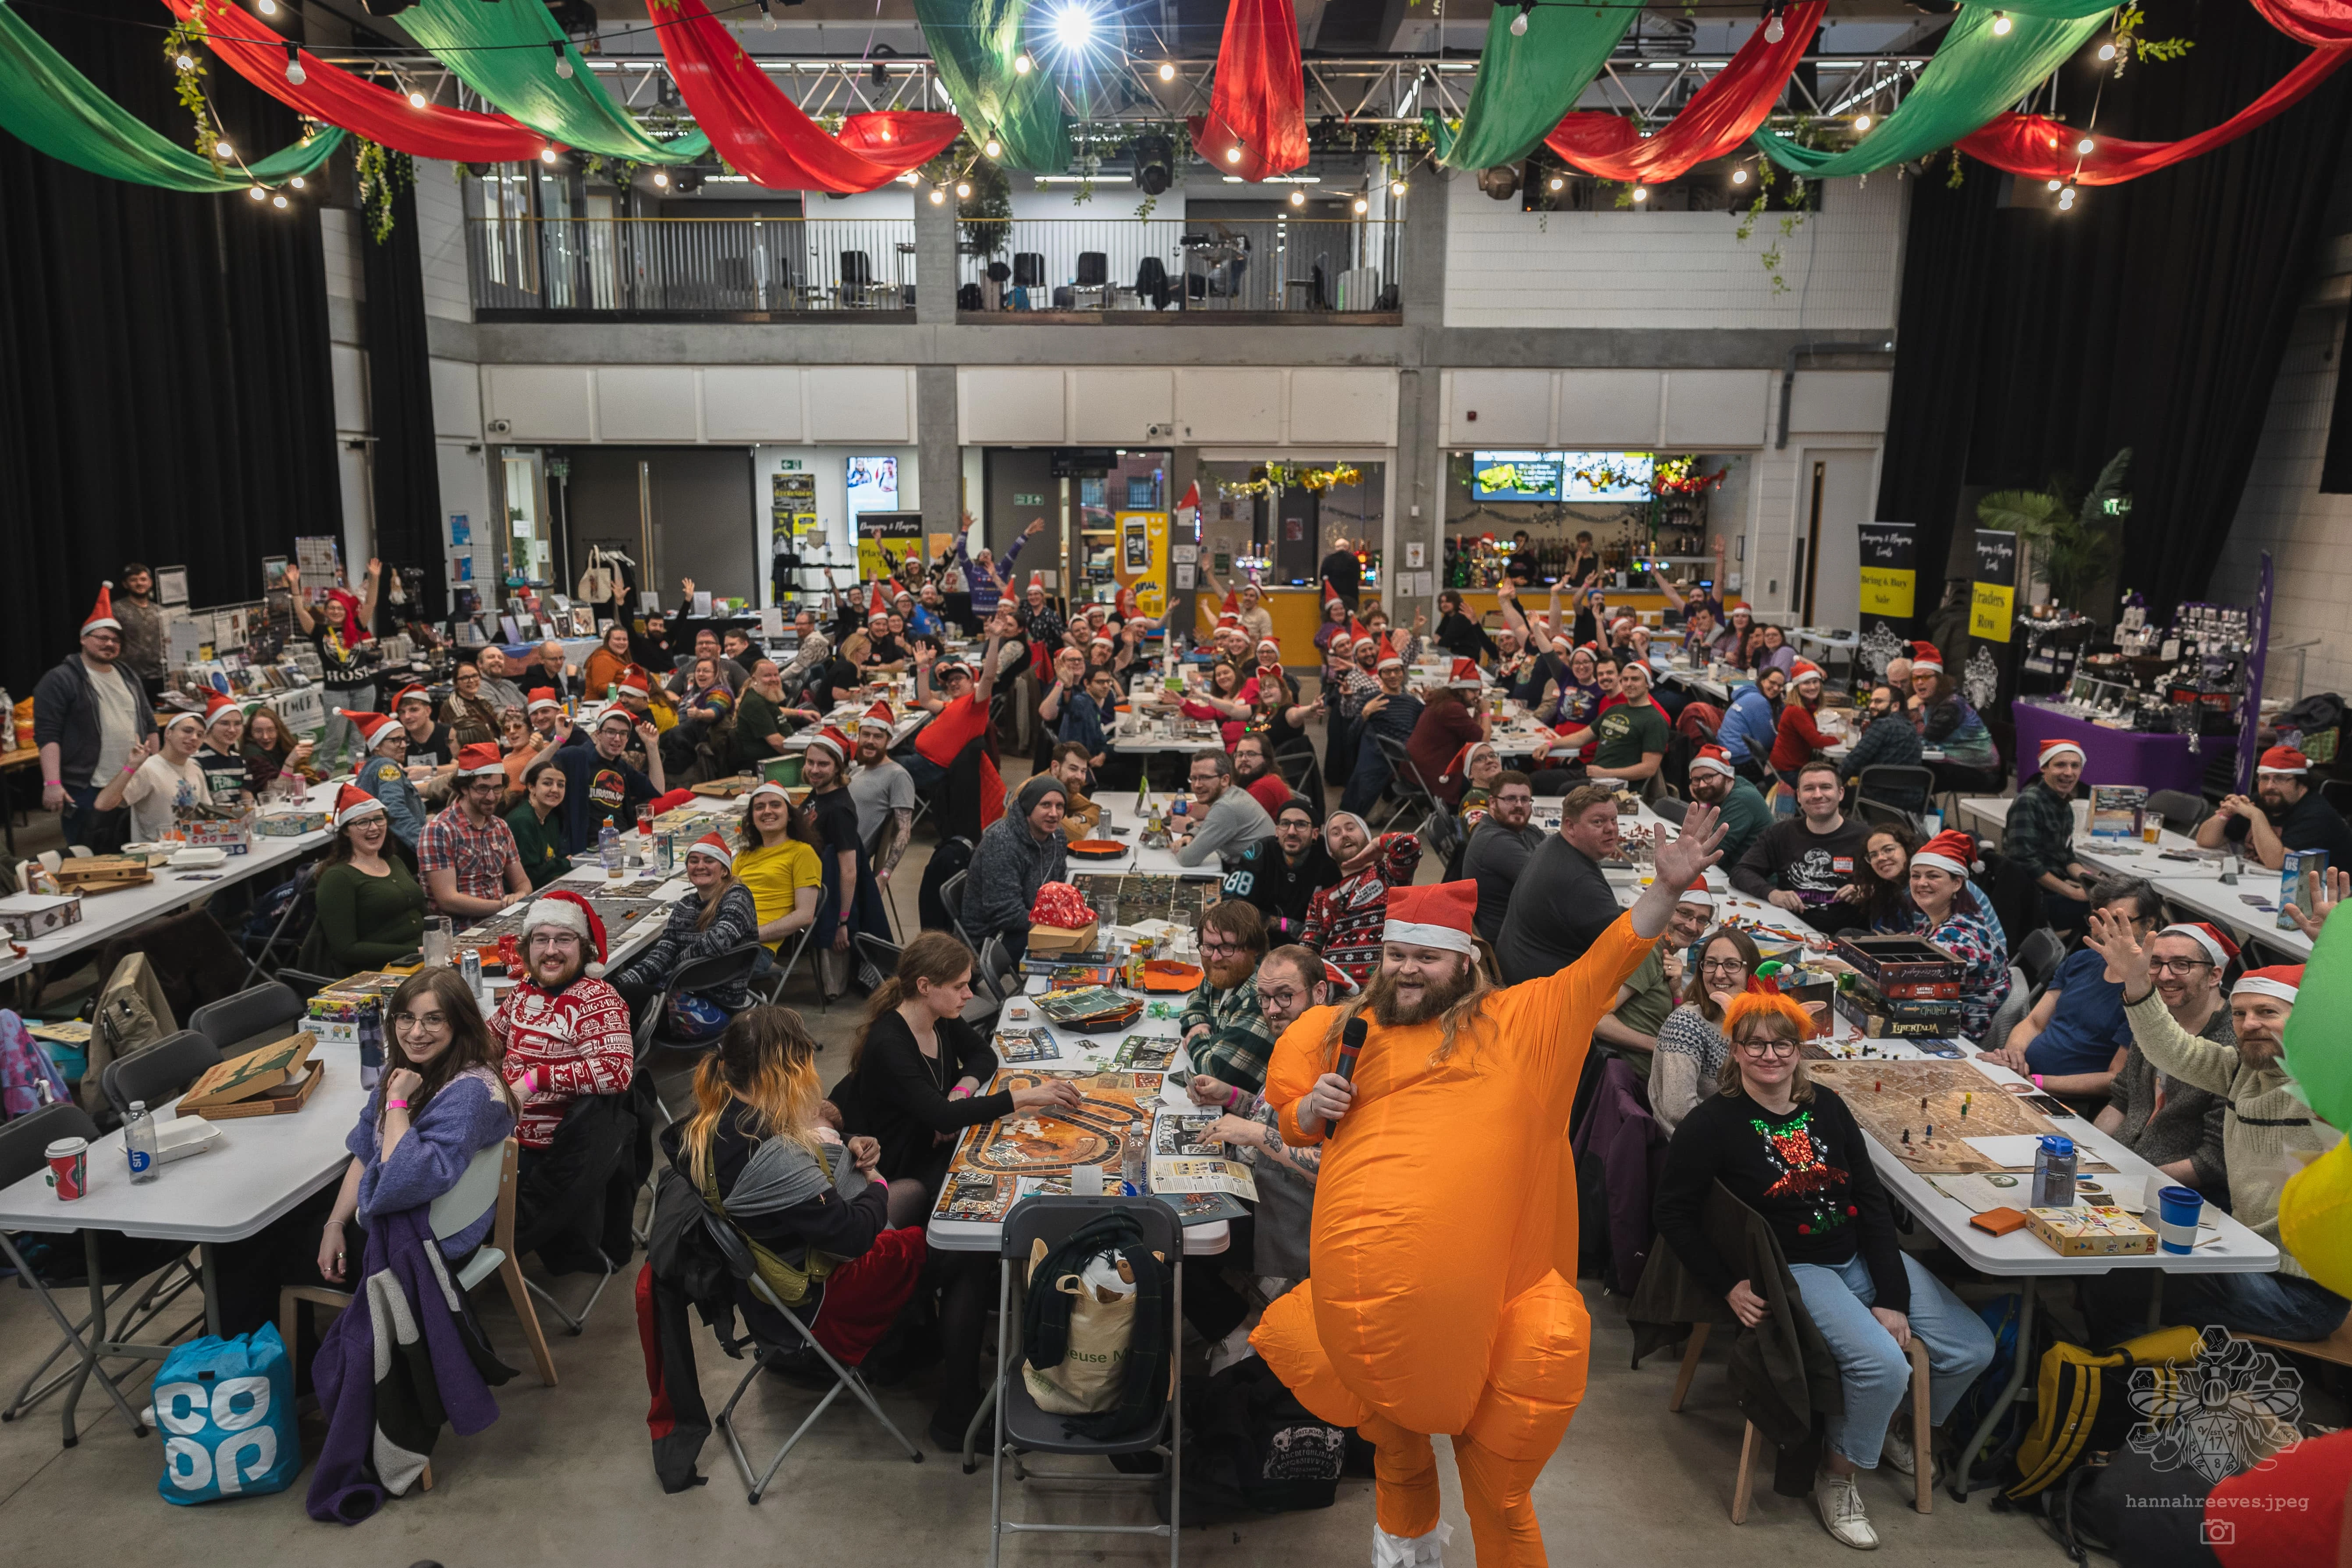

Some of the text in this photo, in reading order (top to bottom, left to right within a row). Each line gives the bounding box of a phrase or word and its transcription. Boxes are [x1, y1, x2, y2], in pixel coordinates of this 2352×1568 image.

[1861, 575, 1882, 587] Bring
[1890, 578, 1907, 590] Buy
[1973, 589, 2006, 608] Traders
[1225, 870, 1254, 896] 88
[582, 1002, 597, 1014] DIG
[605, 998, 618, 1007] DIG
[1890, 1022, 1940, 1035] LIBERTALIA
